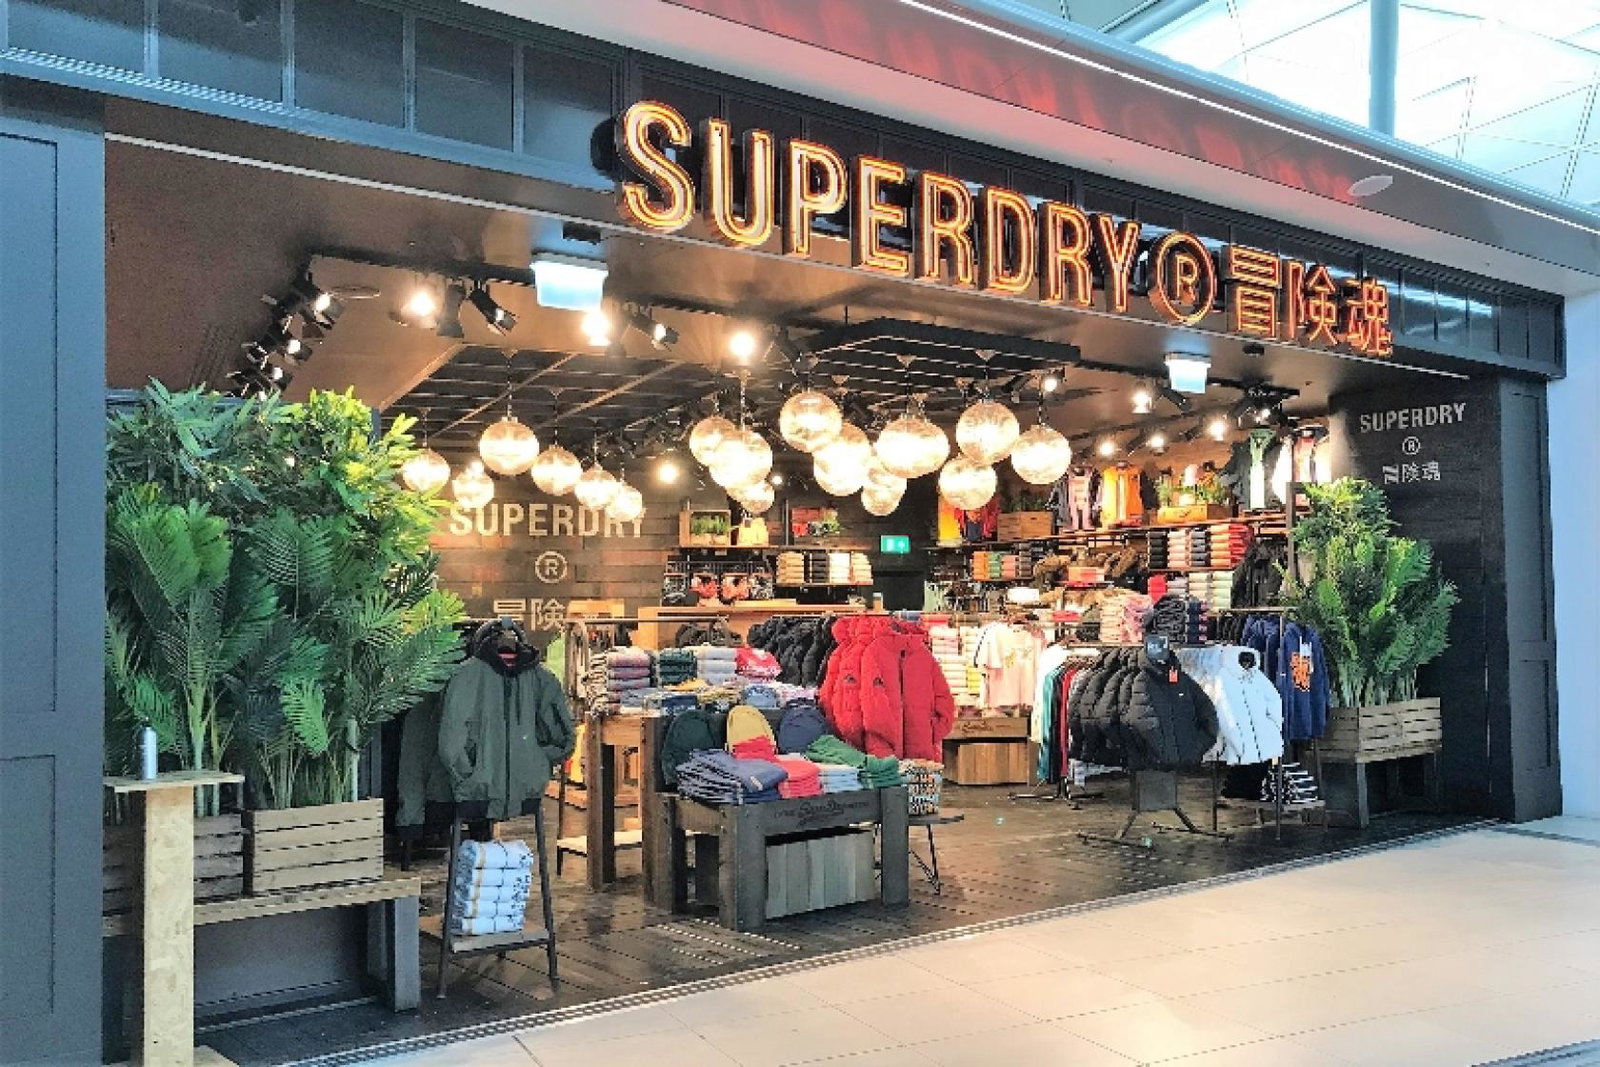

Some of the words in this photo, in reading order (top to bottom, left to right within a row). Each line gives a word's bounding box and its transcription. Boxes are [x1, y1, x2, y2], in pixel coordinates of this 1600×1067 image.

[617, 101, 1142, 313] SUPERDRY
[1230, 244, 1393, 357] 冒険魂
[1360, 402, 1466, 433] SUPERDRY
